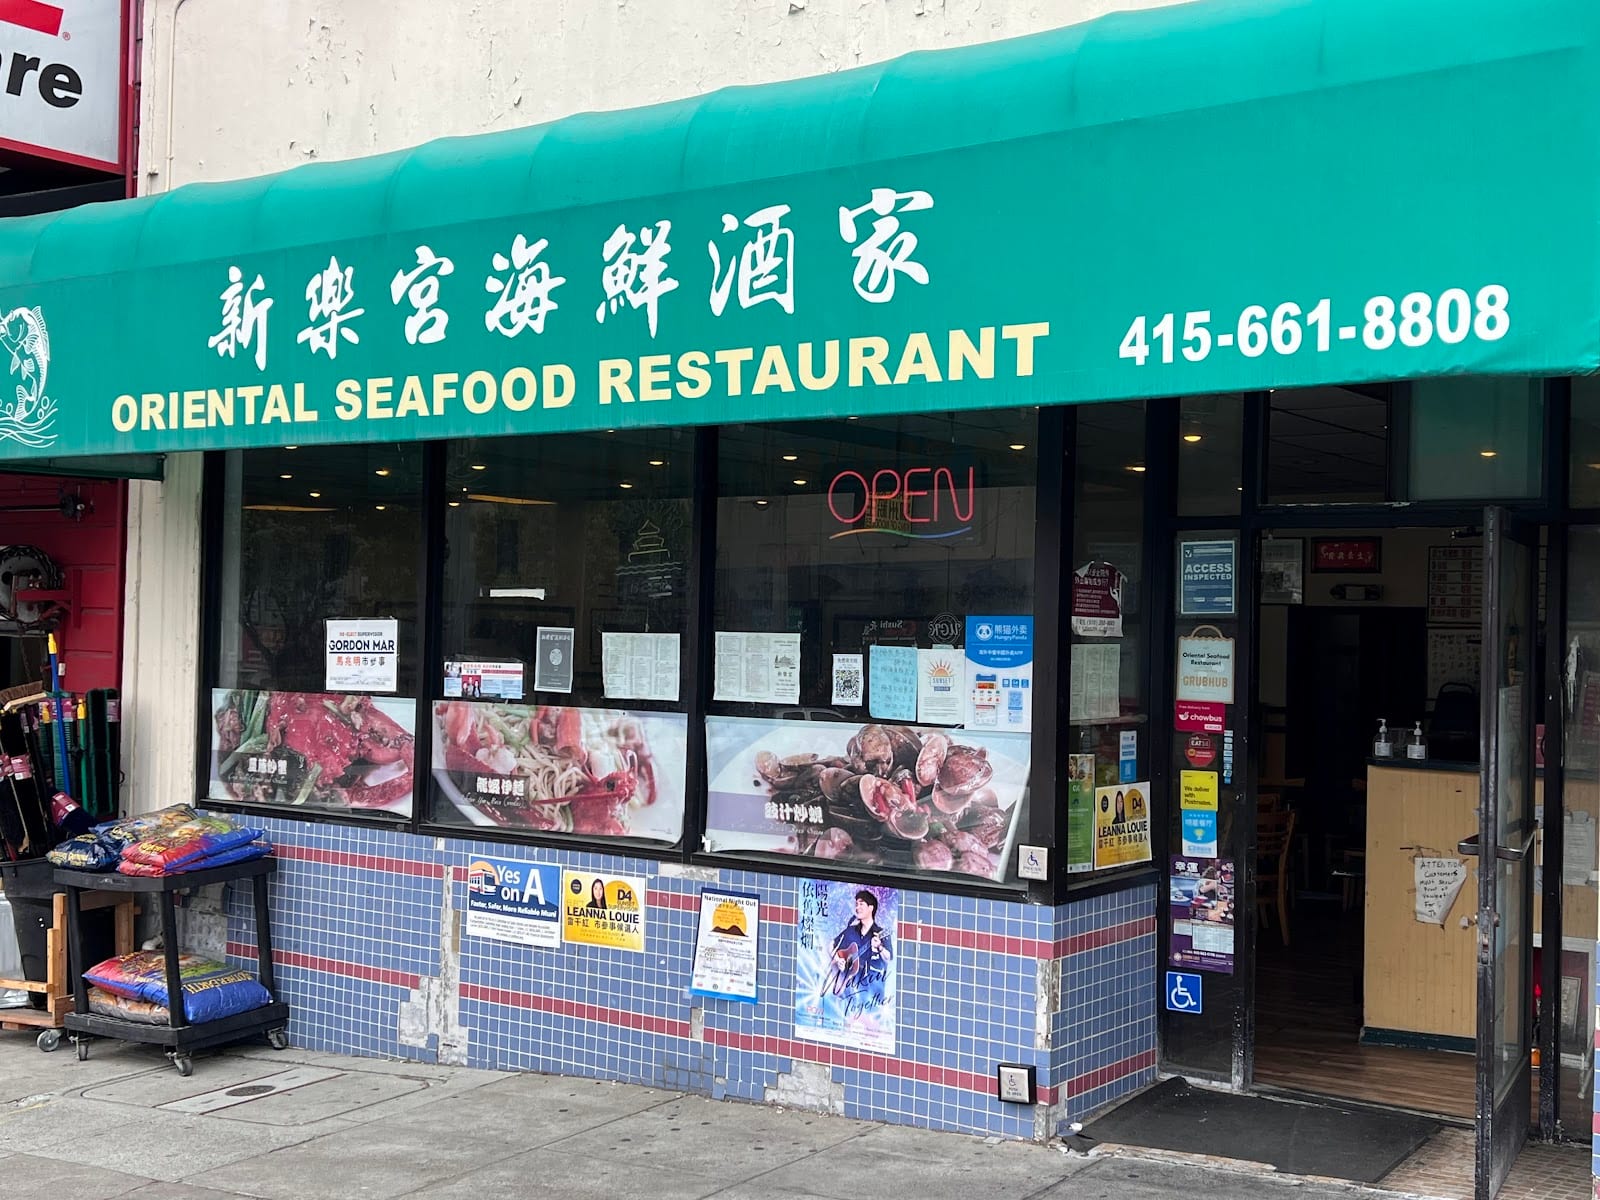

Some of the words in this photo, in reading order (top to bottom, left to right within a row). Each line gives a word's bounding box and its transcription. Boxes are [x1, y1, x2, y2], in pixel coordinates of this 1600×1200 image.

[0, 51, 82, 108] re
[208, 188, 934, 371] 新樂宮海鮮酒家
[1118, 284, 1510, 366] 415-661-8808
[111, 382, 318, 432] ORIENTAL
[335, 364, 576, 420] SEAFOOD
[599, 322, 1050, 404] RESTAURANT
[827, 466, 975, 524] OPEN
[1185, 563, 1232, 573] ACCESS
[994, 624, 1028, 635] 熊猫外卖
[329, 640, 370, 650] GORDON
[372, 640, 395, 650] MAR
[1183, 675, 1228, 688] GRUBHUB
[1190, 713, 1222, 722] chowbus
[1132, 797, 1142, 809] D4
[1099, 825, 1126, 838] LEANNA
[1127, 821, 1147, 833] LOUIE
[497, 865, 520, 884] Yes
[501, 887, 520, 902] on
[522, 868, 546, 905] A
[617, 889, 632, 901] D4
[470, 899, 487, 909] Faster,
[503, 904, 516, 913] More
[518, 907, 540, 916] Reliable
[704, 895, 728, 903] National
[815, 883, 829, 917] 陽光
[567, 906, 607, 920] LEANNA
[609, 911, 640, 924] LOUIE
[840, 990, 892, 1020] Together
